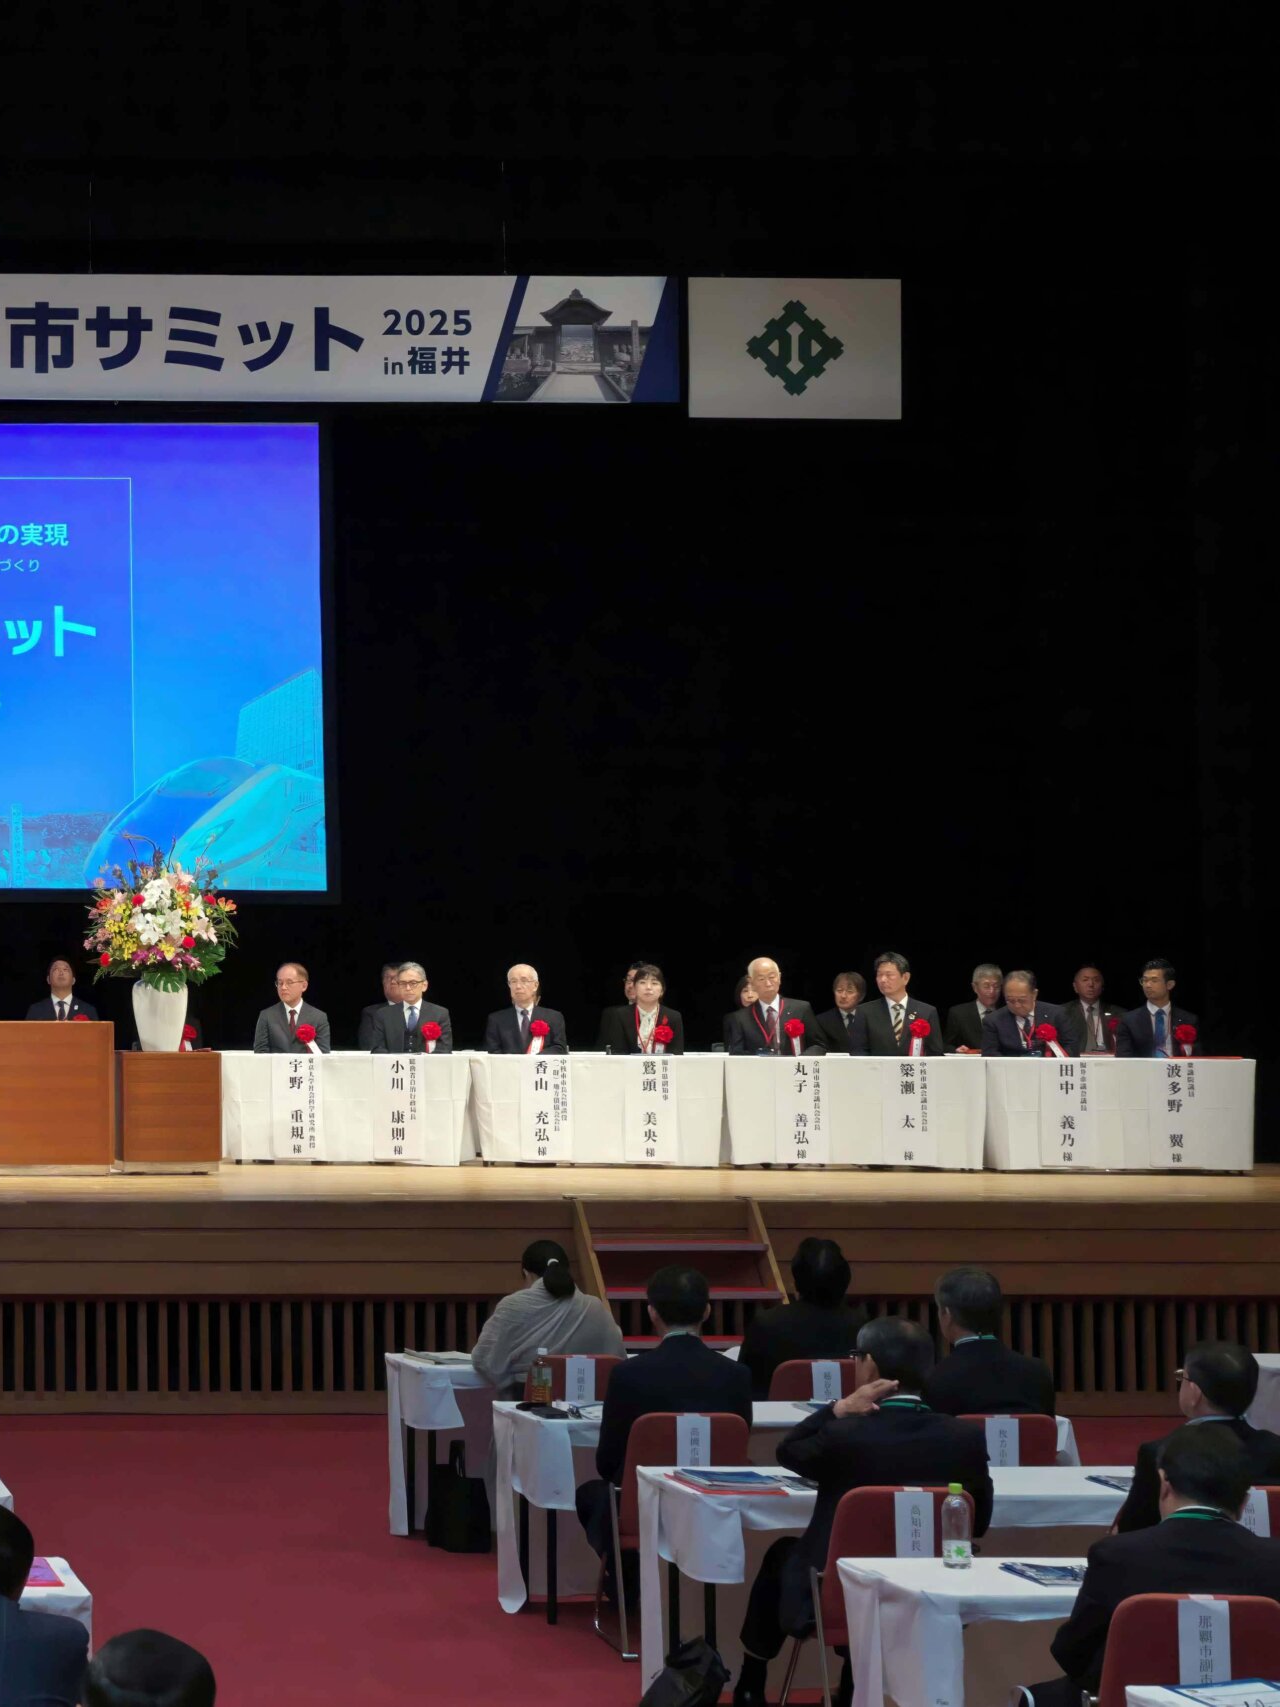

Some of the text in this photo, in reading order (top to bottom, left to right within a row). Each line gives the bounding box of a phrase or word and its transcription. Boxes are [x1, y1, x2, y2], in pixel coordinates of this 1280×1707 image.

[382, 309, 471, 335] 2025
[288, 1058, 304, 1090] 宇野
[391, 1059, 405, 1091] 小川
[534, 1060, 548, 1092] 香山
[642, 1060, 657, 1092] 鷲頭
[795, 1061, 808, 1094] 丸子
[1059, 1063, 1074, 1095] 田中
[1166, 1063, 1183, 1113] 波多野
[902, 1114, 915, 1129] 太
